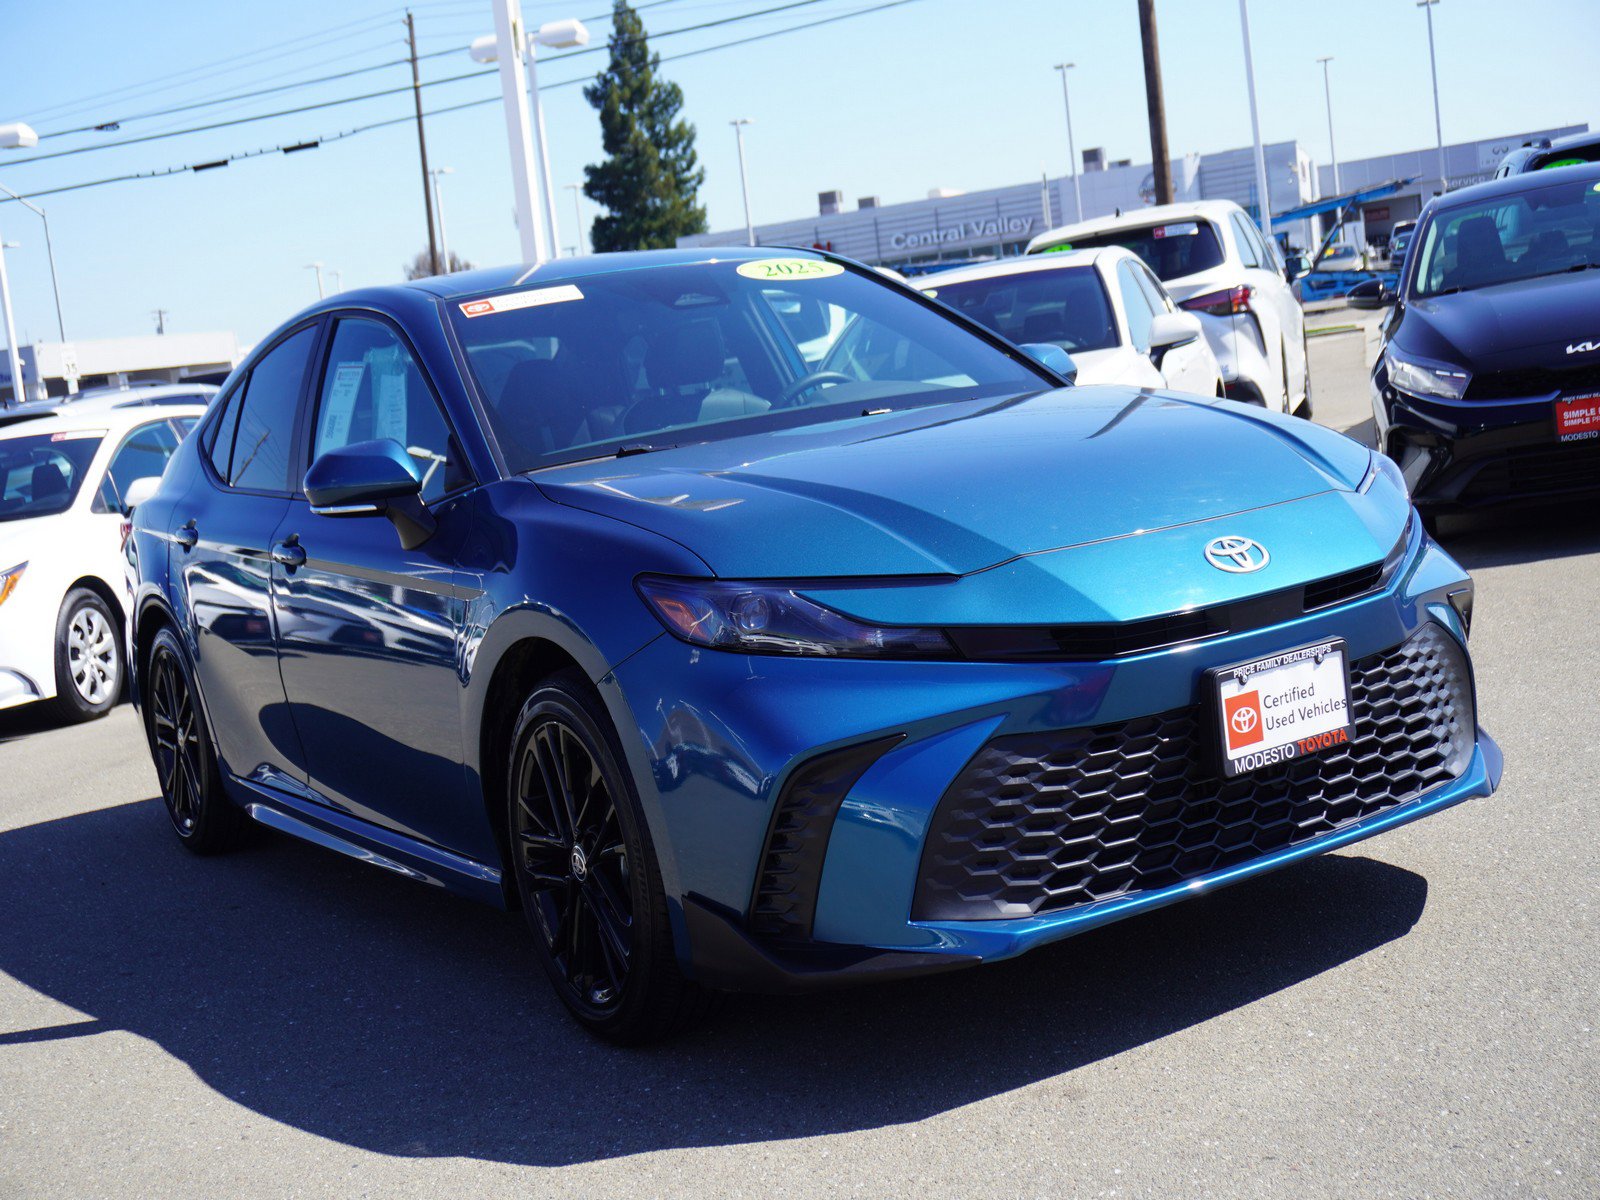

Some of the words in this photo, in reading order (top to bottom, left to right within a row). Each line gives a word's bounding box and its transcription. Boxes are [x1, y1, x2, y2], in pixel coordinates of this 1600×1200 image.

[890, 224, 965, 250] Central
[971, 215, 1034, 238] Valley
[759, 262, 824, 277] 2025
[1563, 407, 1596, 420] SIMPLE
[1564, 417, 1590, 427] SIMPLE
[1561, 430, 1598, 442] MODESTO
[1233, 665, 1256, 678] PRICE
[1256, 659, 1282, 672] FAMILY
[1283, 645, 1332, 665] DEALERSHIPS
[1263, 683, 1315, 709] Certified
[1265, 710, 1295, 730] Used
[1298, 698, 1347, 721] Vehicles
[1234, 743, 1295, 774] MODESTO
[1297, 728, 1348, 756] TOYOTA
